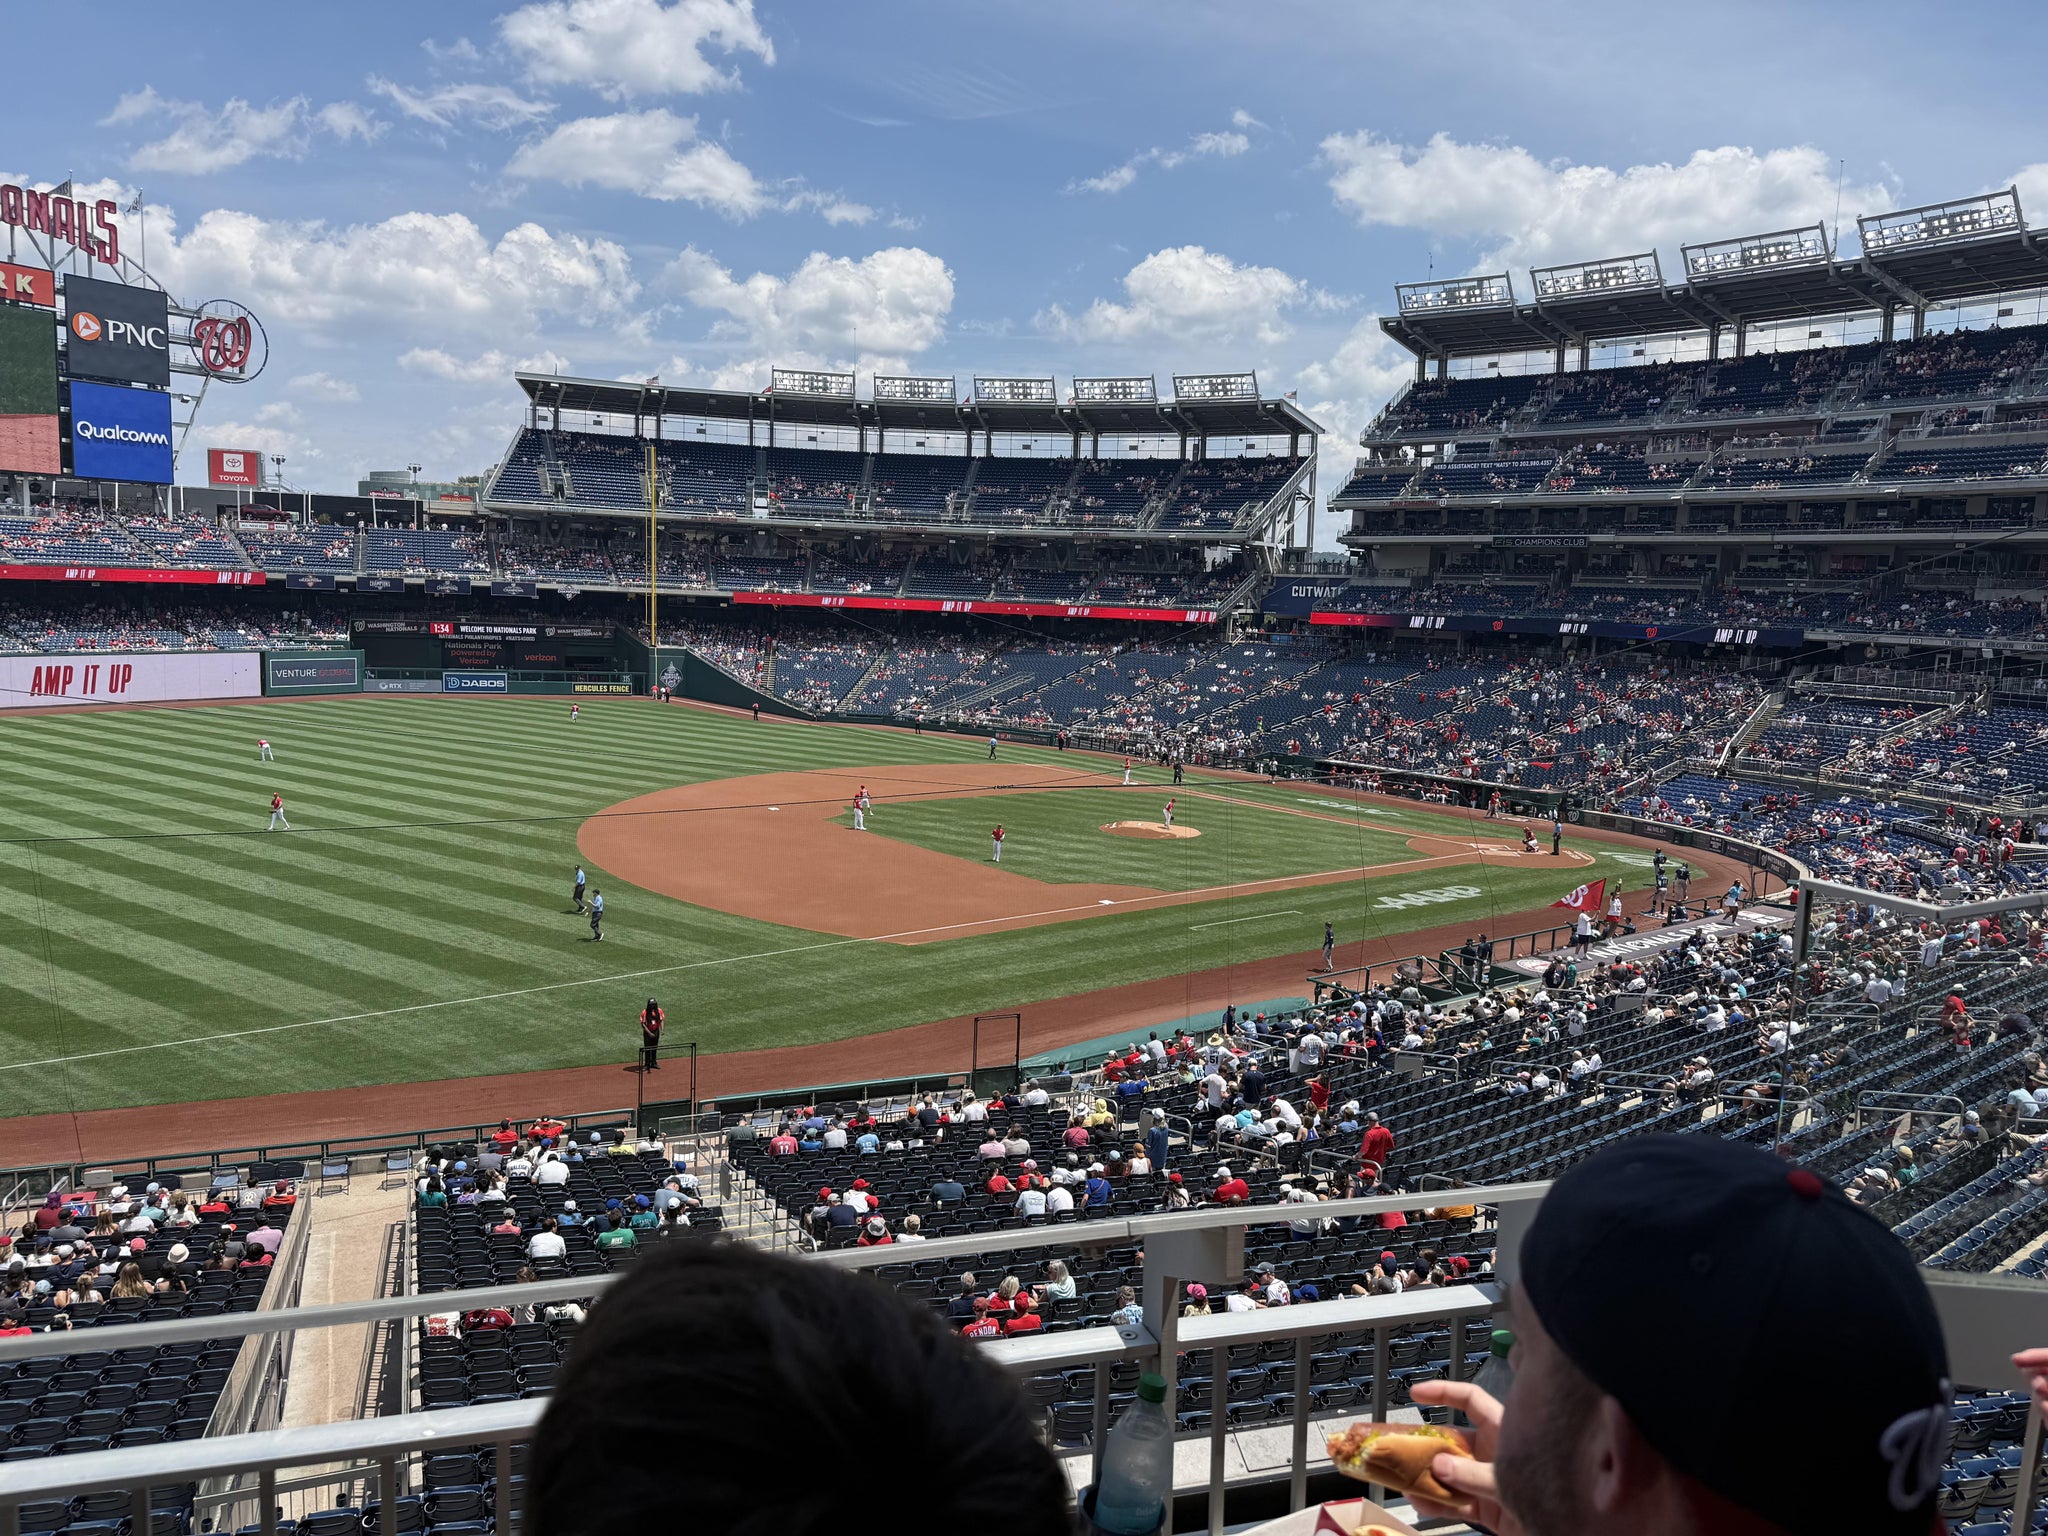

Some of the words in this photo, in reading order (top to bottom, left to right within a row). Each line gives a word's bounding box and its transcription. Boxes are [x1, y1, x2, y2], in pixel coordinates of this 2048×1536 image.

[104, 319, 166, 350] PNC
[76, 420, 169, 445] Qualcomm
[1514, 538, 1561, 546] CHAMPIONS
[1562, 538, 1585, 546] CLUB
[65, 568, 78, 579] AMP
[80, 569, 86, 579] IT
[87, 569, 96, 579] UP
[217, 572, 232, 583] AMP
[234, 572, 241, 584] IT
[242, 572, 252, 584] UP
[821, 596, 831, 605] AMP
[838, 597, 845, 606] UP
[941, 601, 955, 612] AMP
[956, 601, 962, 612] IT
[964, 602, 973, 612] UP
[1067, 607, 1077, 615] AMP
[1084, 608, 1090, 616] UP
[1185, 611, 1199, 622] AMP
[1200, 611, 1207, 622] IT
[1208, 612, 1217, 623] UP
[1409, 616, 1424, 628] AMP
[1426, 616, 1433, 629] IT
[1435, 617, 1445, 629] UP
[434, 624, 449, 633] 1:34
[460, 625, 485, 633] WELCOME
[493, 626, 522, 634] NATIONALS
[1559, 623, 1572, 633] AMP
[1572, 624, 1579, 633] IT
[1580, 624, 1588, 634] UP
[1714, 629, 1733, 642] AMP
[1735, 629, 1744, 643] IT
[1745, 630, 1758, 644] UP
[483, 642, 502, 650] Park
[486, 649, 497, 657] by
[460, 656, 489, 664] Verizon
[276, 668, 317, 677] VENTURE
[30, 665, 73, 696] AMP
[82, 664, 99, 695] IT
[108, 664, 133, 693] UP
[575, 684, 608, 692] HERCULES
[609, 685, 630, 693] FENCE
[1209, 1055, 1219, 1064] 51
